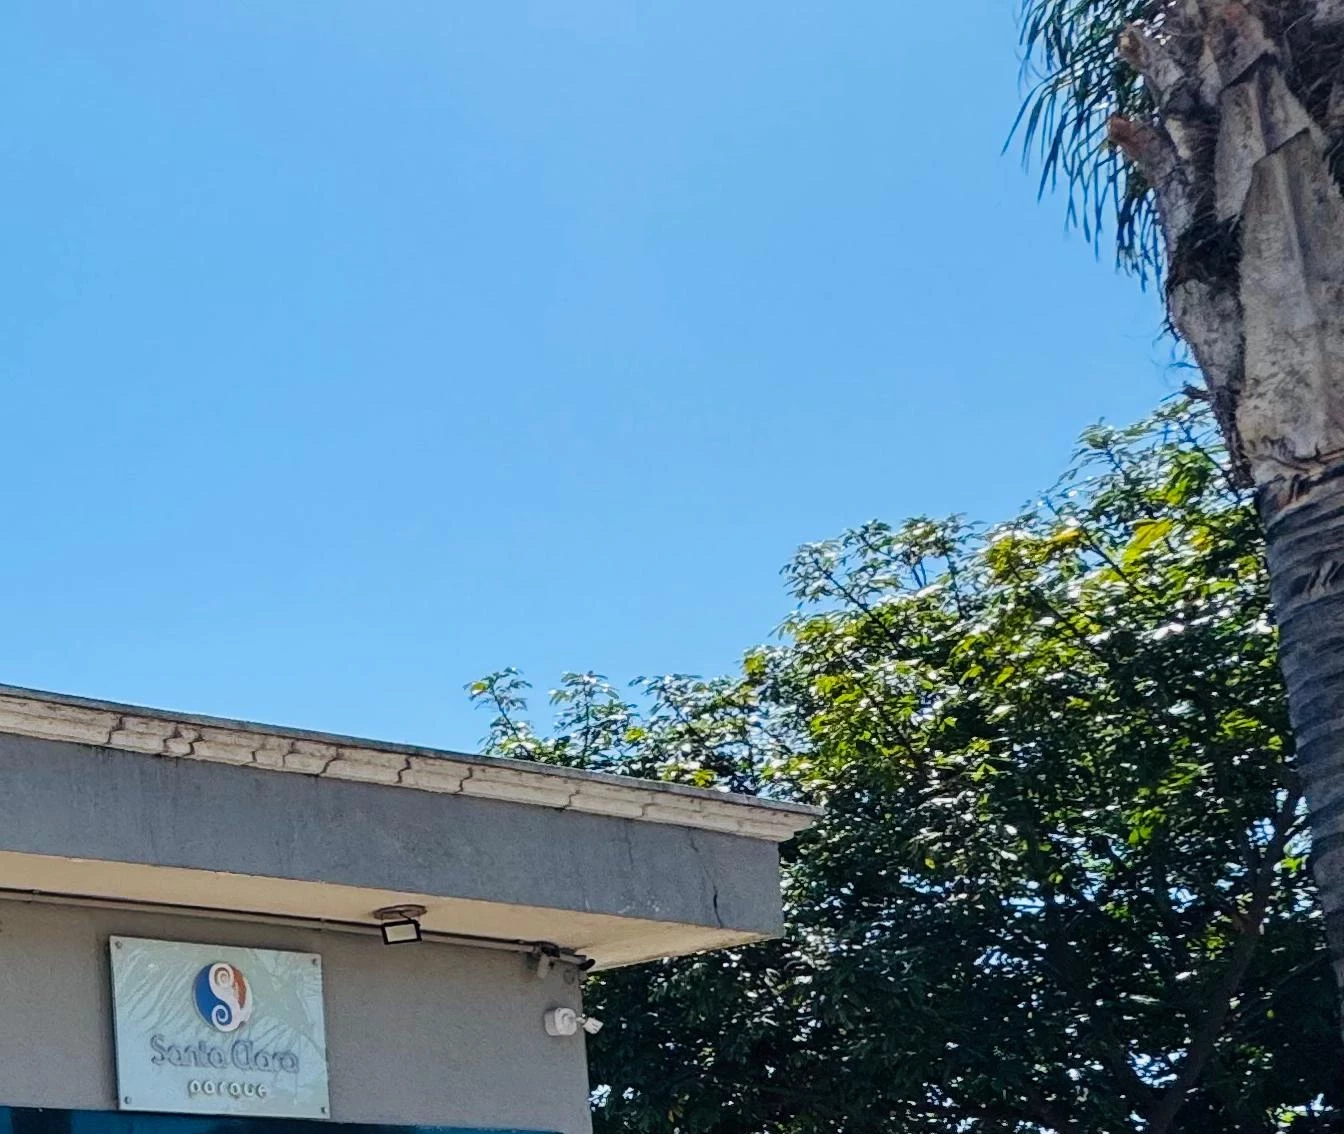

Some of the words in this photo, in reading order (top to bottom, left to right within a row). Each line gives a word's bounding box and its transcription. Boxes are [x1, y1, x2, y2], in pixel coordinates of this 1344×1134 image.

[150, 1034, 227, 1068] Santa
[231, 1039, 300, 1074] Clara
[187, 1079, 267, 1100] parque
